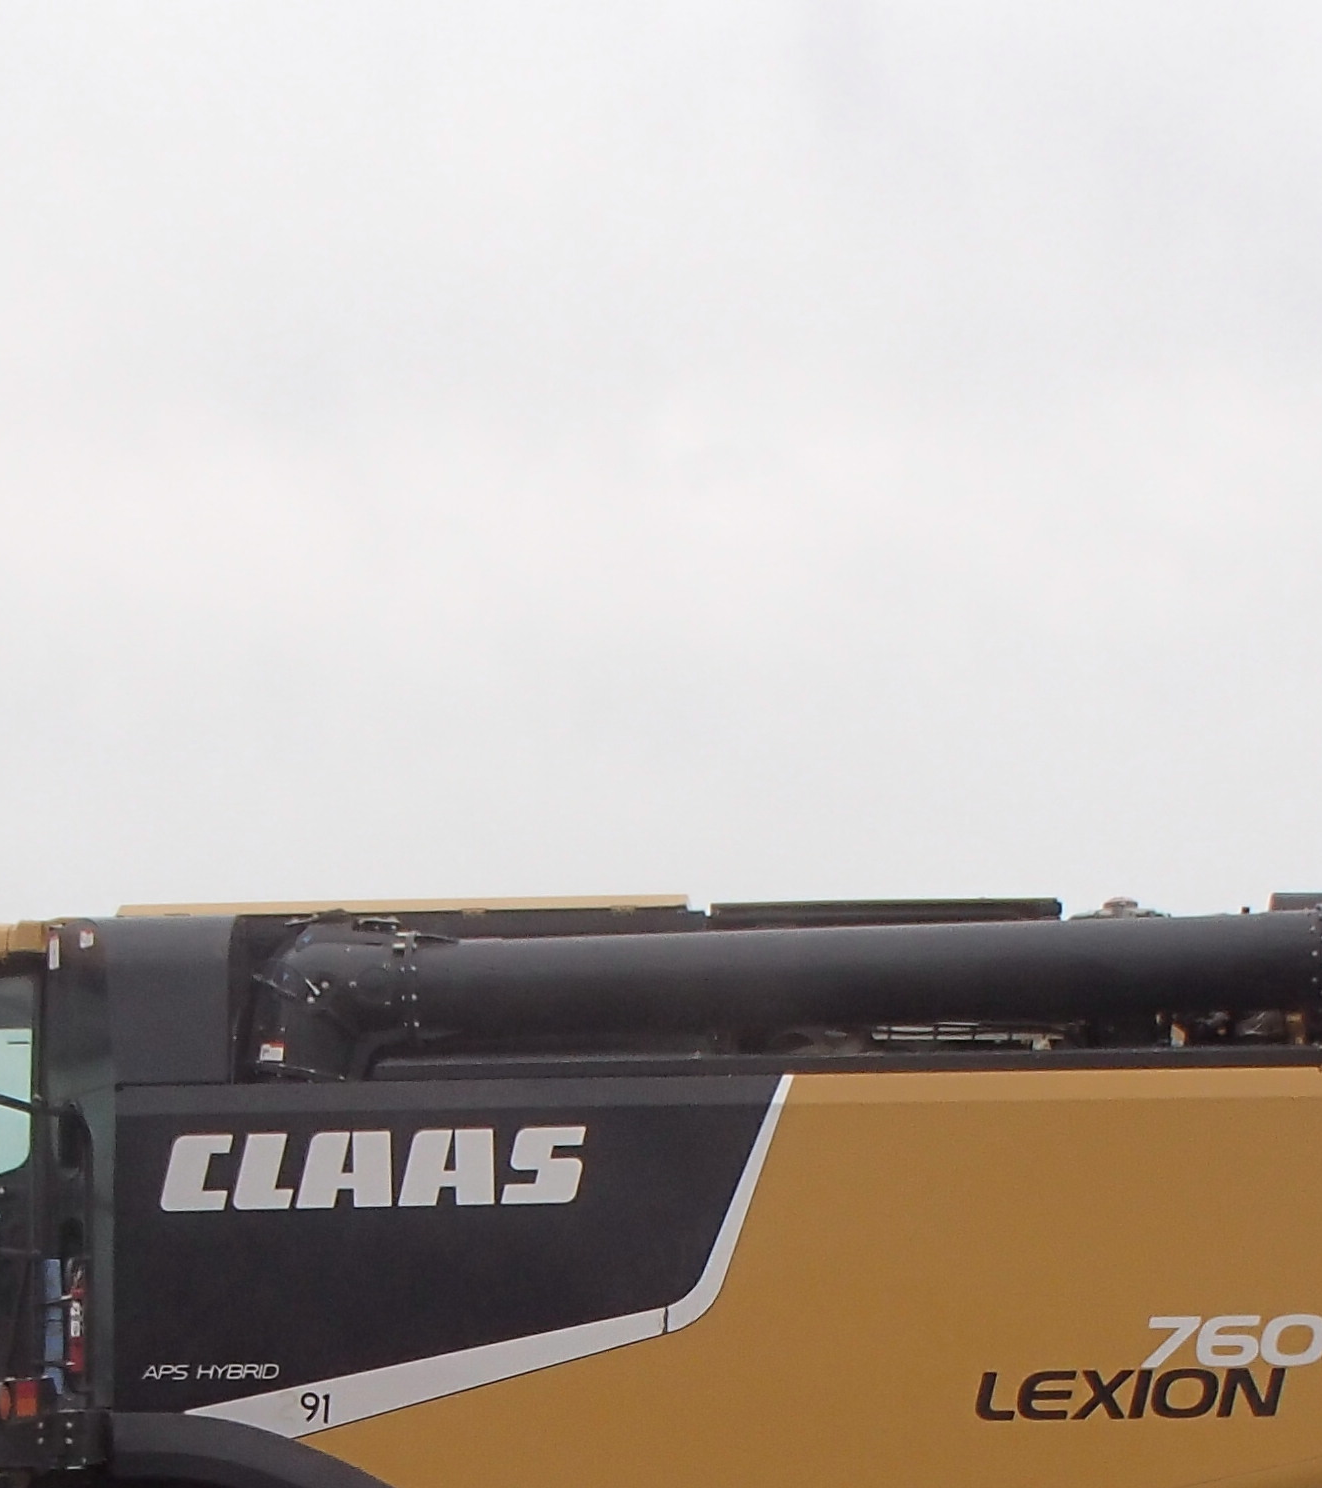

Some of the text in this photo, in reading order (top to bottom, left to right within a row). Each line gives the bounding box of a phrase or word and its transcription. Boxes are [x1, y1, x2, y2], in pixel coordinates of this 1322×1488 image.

[160, 1126, 586, 1212] CLAAS
[142, 1363, 280, 1380] APS HYBRID
[300, 1392, 331, 1424] 91
[975, 1367, 1286, 1421] LEXION
